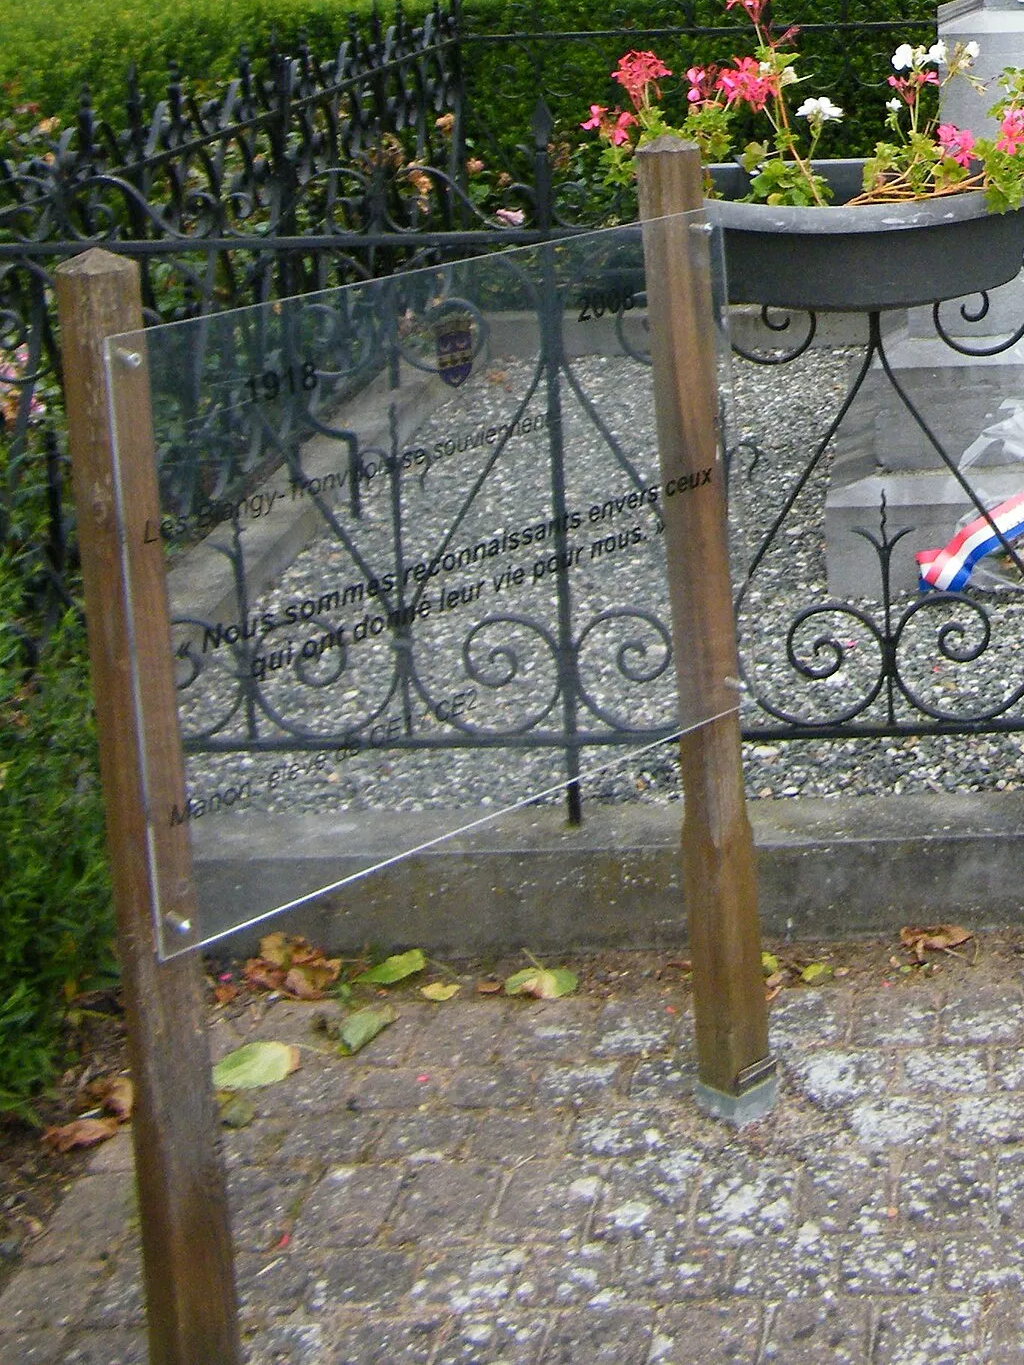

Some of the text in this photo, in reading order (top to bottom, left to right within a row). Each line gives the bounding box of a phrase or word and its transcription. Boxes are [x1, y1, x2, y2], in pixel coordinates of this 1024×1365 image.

[143, 512, 186, 545] Les
[401, 447, 426, 469] se
[202, 614, 275, 653] Nous
[285, 574, 397, 625] sommes
[403, 510, 581, 585] reconnaissants
[589, 485, 659, 522] envers
[665, 468, 713, 497] ceux
[251, 640, 293, 682] qui
[439, 579, 484, 612] leur
[493, 565, 526, 592] vie
[532, 545, 583, 587] pour
[434, 688, 479, 722] CE2
